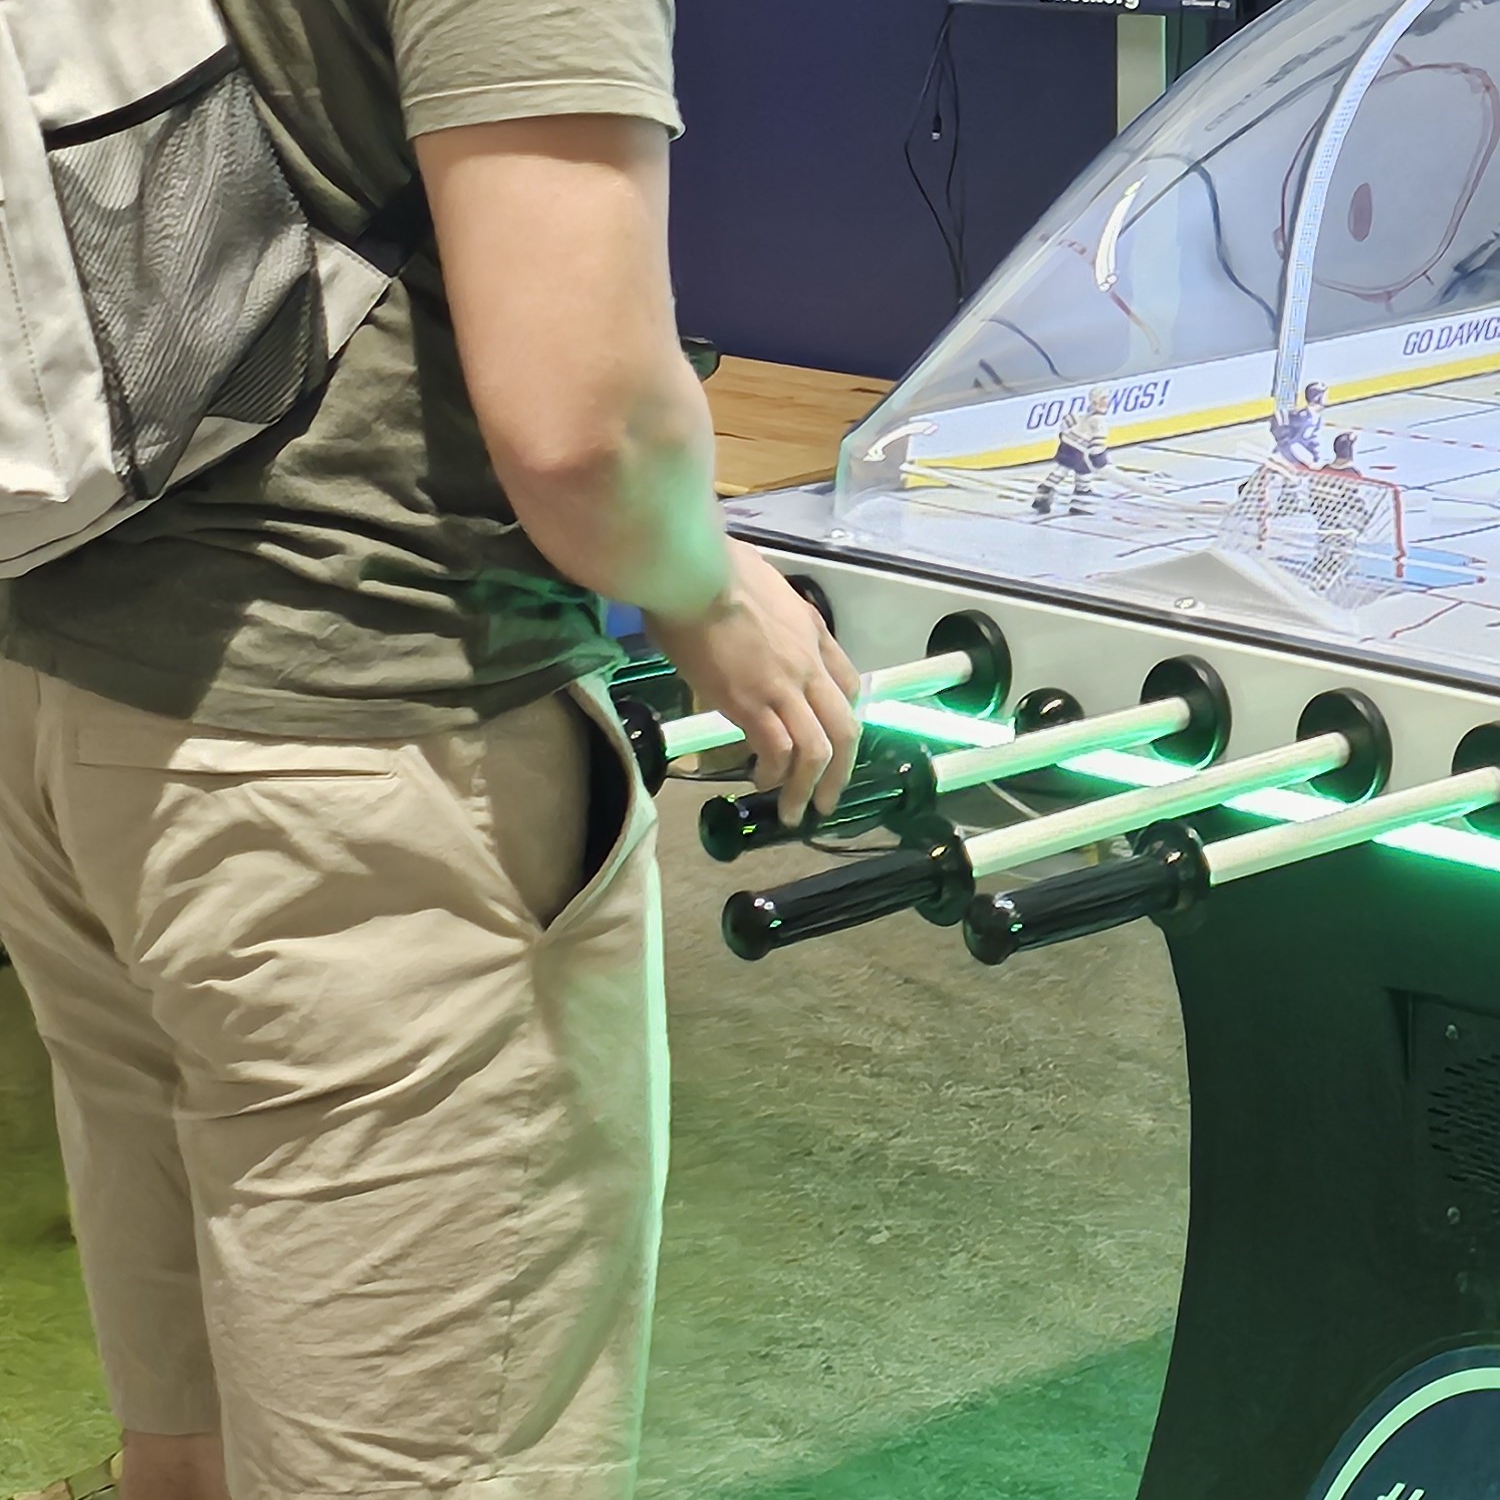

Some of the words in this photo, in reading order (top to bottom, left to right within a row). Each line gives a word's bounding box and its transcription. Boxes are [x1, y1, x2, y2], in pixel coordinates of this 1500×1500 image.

[1402, 329, 1434, 356] GO
[1026, 400, 1064, 430] GO
[1070, 379, 1171, 416] DWGS!
